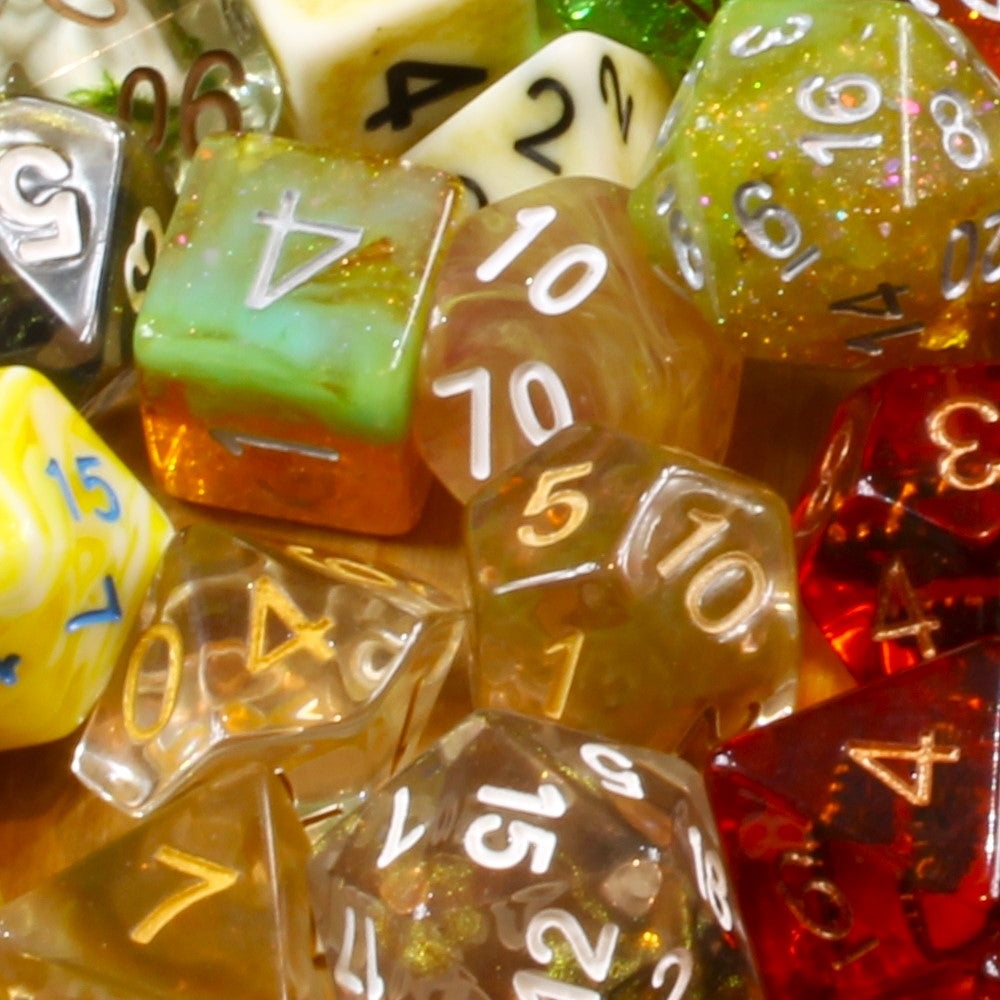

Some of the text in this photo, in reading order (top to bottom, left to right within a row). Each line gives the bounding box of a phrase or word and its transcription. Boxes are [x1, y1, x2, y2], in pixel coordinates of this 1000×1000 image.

[364, 60, 488, 132] 4
[513, 76, 575, 176] 2
[599, 54, 634, 145] 2
[929, 88, 989, 171] 8
[245, 188, 365, 312] 4
[475, 205, 608, 317] 10
[431, 360, 574, 481] 70
[44, 455, 122, 524] 15
[516, 461, 594, 548] 5
[656, 507, 769, 634] 10
[580, 743, 644, 800] 5
[845, 730, 961, 806] 4
[463, 784, 569, 874] 15
[130, 845, 239, 945] 7
